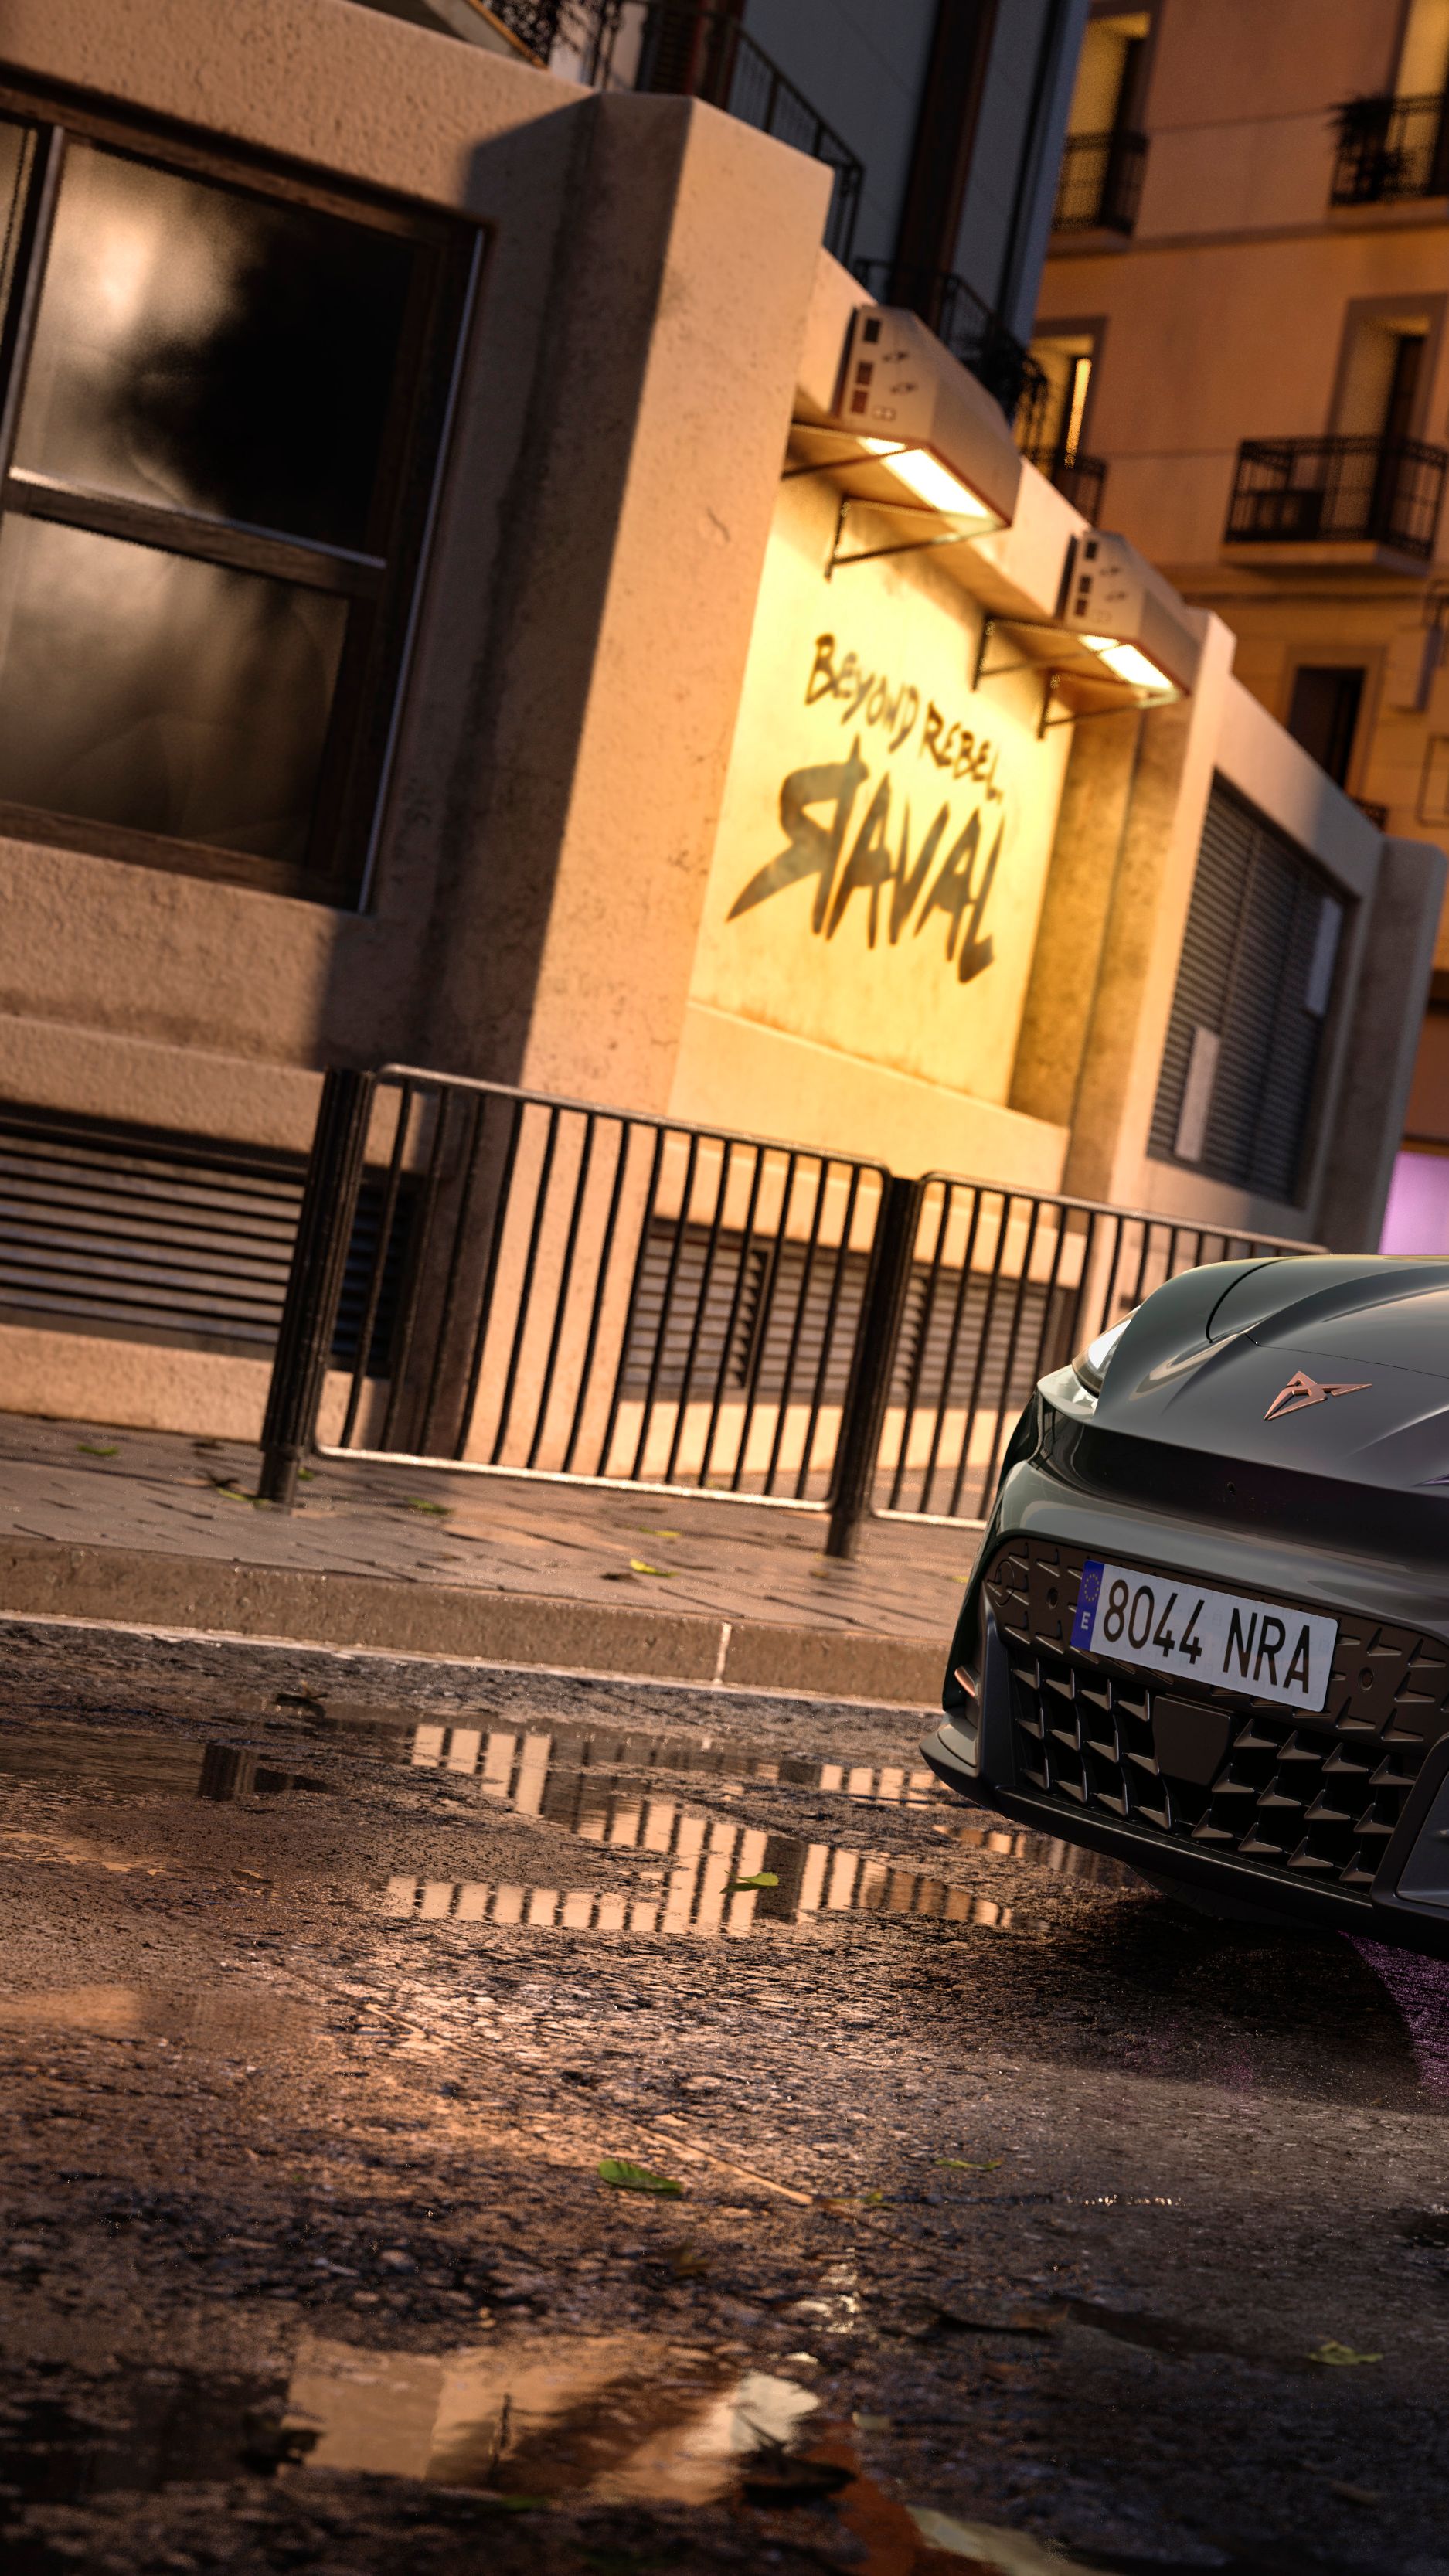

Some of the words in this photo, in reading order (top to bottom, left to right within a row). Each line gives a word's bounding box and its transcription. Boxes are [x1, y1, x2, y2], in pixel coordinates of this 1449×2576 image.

[805, 633, 920, 754] BEYOND
[919, 701, 1002, 805] REBEL
[1080, 1611, 1091, 1630] E
[1103, 1579, 1205, 1665] 8044
[1223, 1608, 1309, 1693] NRA
